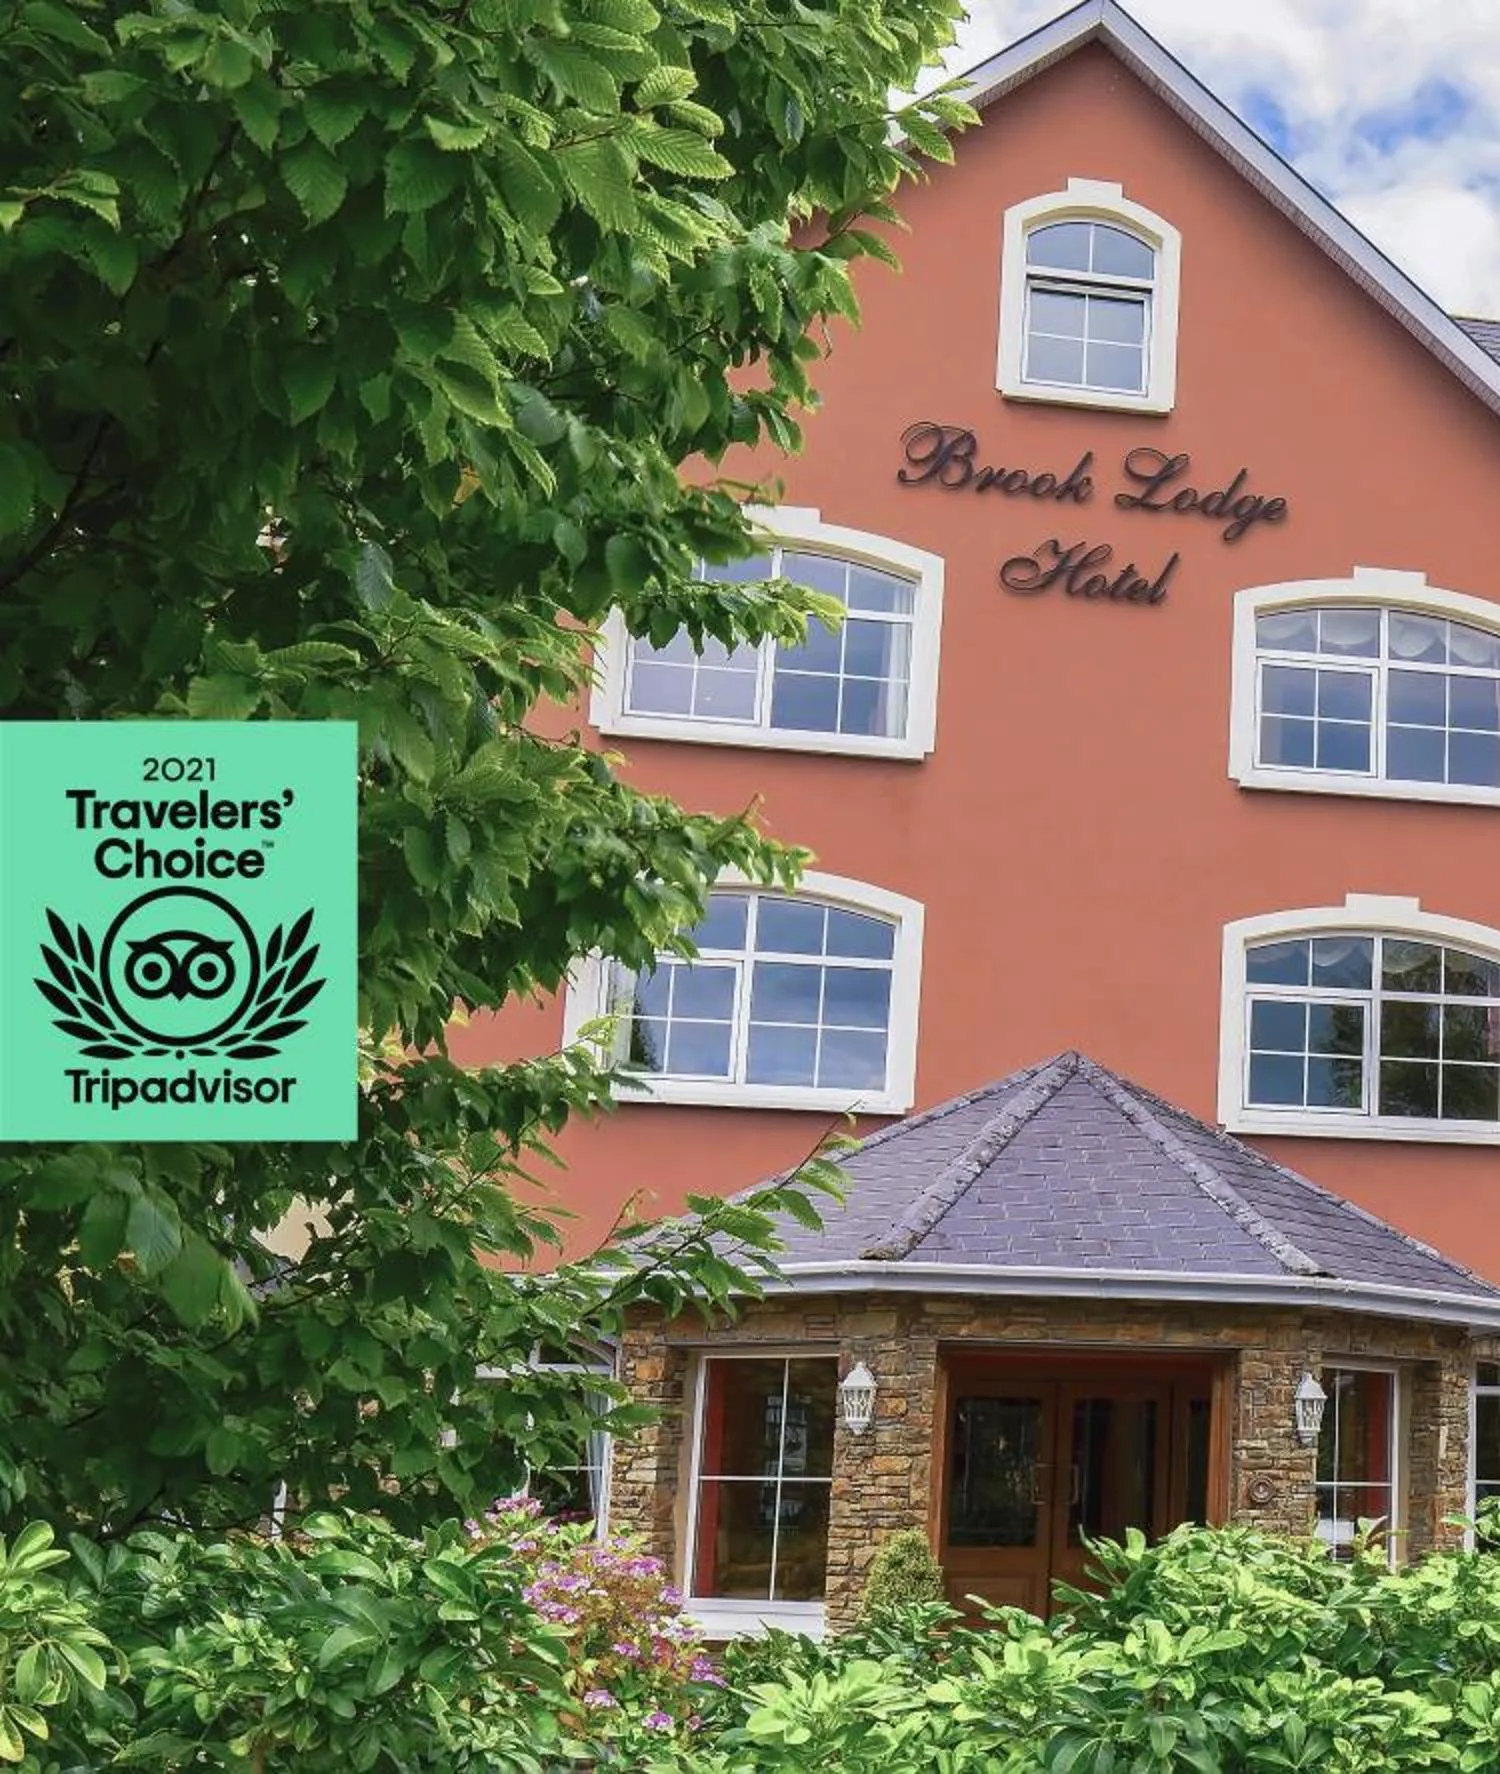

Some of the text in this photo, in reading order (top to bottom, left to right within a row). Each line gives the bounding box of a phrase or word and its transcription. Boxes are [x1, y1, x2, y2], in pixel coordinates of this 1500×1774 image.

[897, 421, 1288, 543] Brook Lodge
[1000, 539, 1180, 605] Hotel
